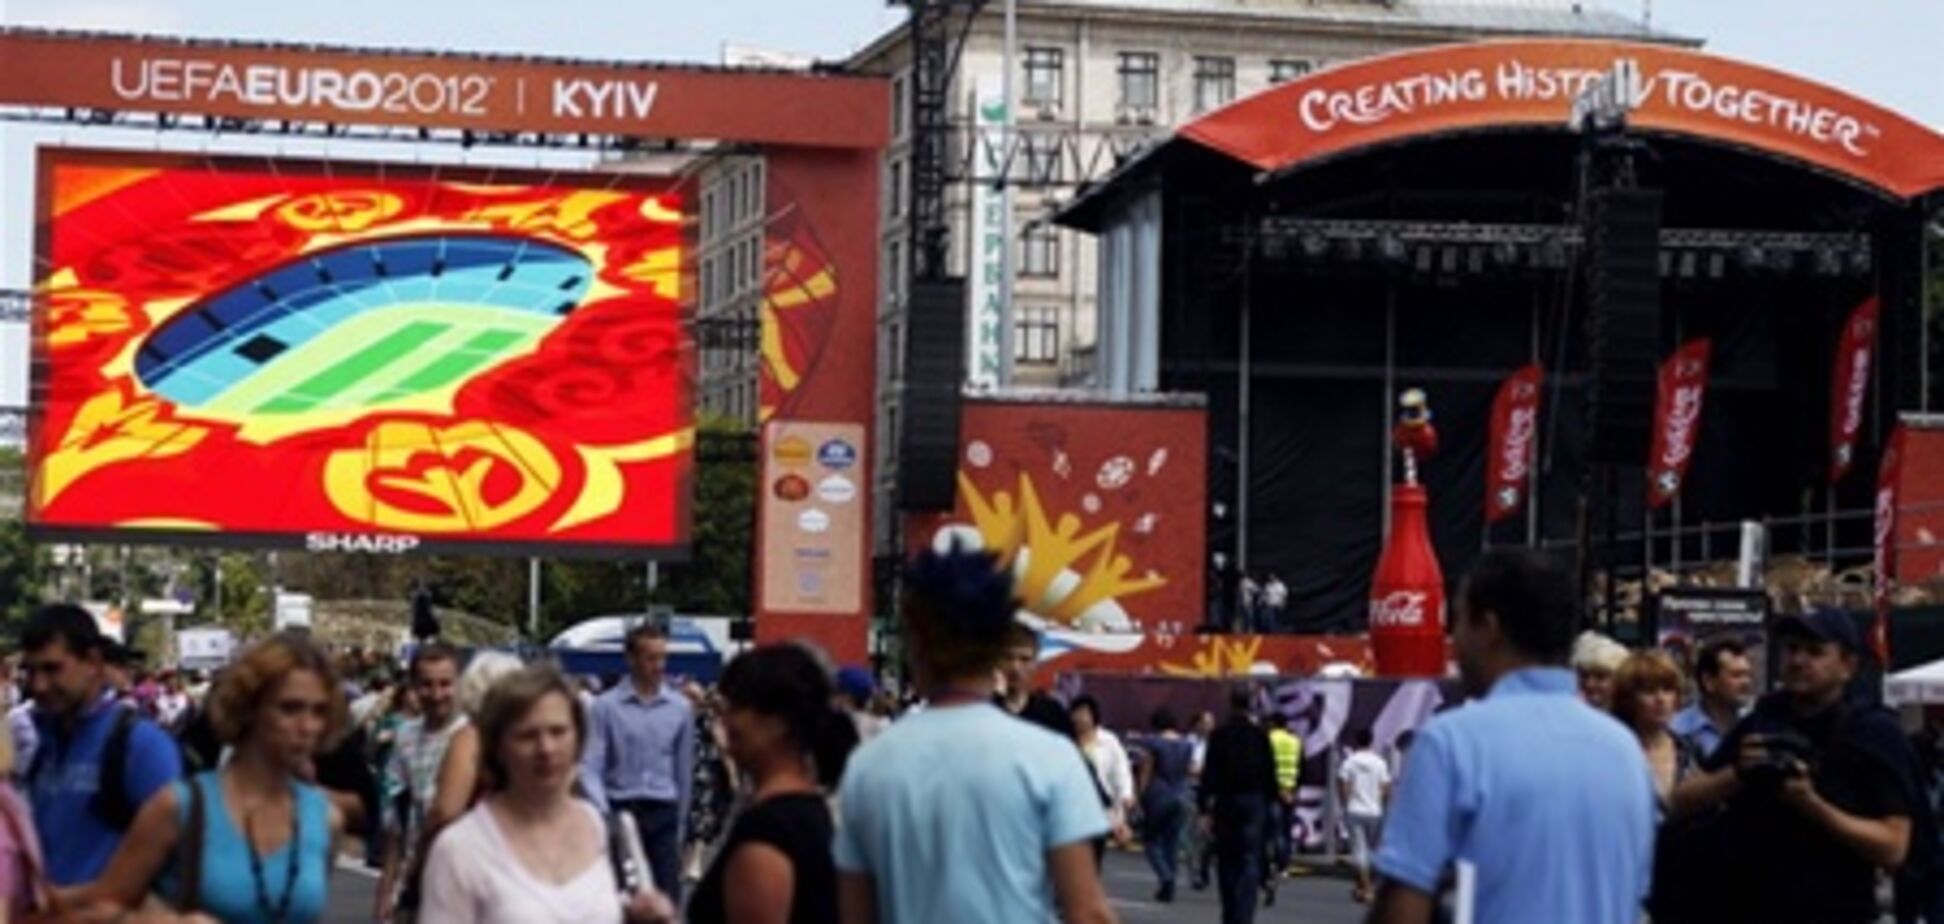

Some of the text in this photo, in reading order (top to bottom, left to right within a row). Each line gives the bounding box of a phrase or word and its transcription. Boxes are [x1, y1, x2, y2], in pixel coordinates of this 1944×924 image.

[553, 79, 658, 118] KYIV
[1299, 69, 1486, 132] CREATING
[306, 532, 420, 553] SHARP
